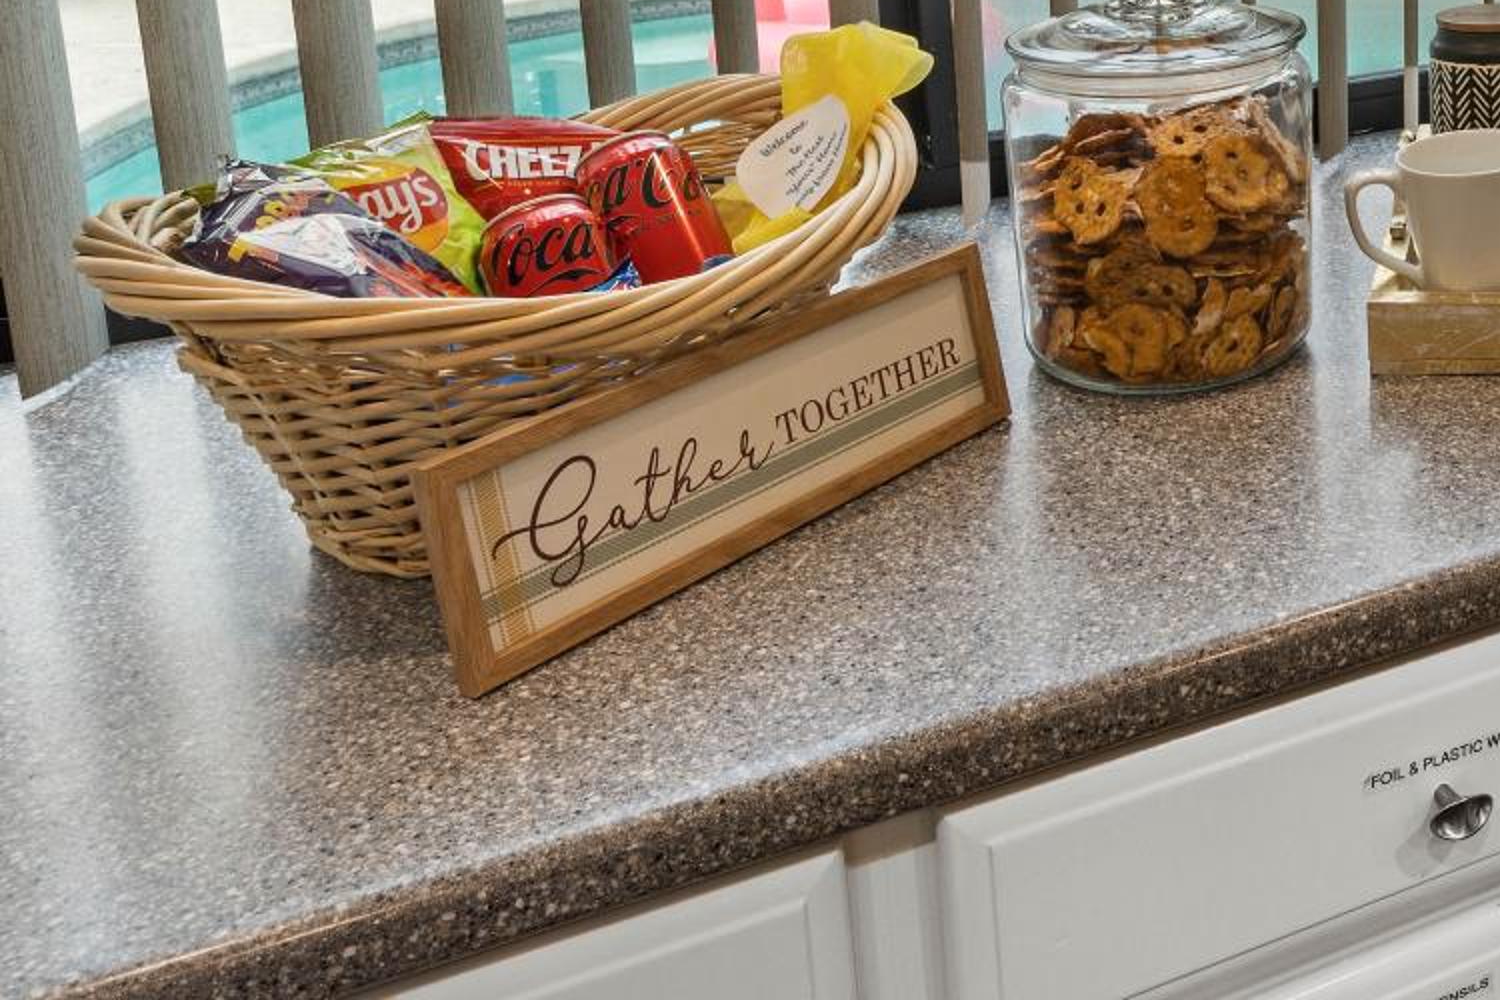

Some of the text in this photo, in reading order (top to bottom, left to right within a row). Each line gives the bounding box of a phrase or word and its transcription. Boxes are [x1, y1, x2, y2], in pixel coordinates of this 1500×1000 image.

[466, 140, 604, 181] CHEEZ
[345, 173, 438, 233] ay's
[492, 336, 961, 587] Gather TOGETHER
[1370, 770, 1405, 788] FOIL
[1409, 761, 1419, 776] &
[1423, 739, 1484, 771] PLASTIC
